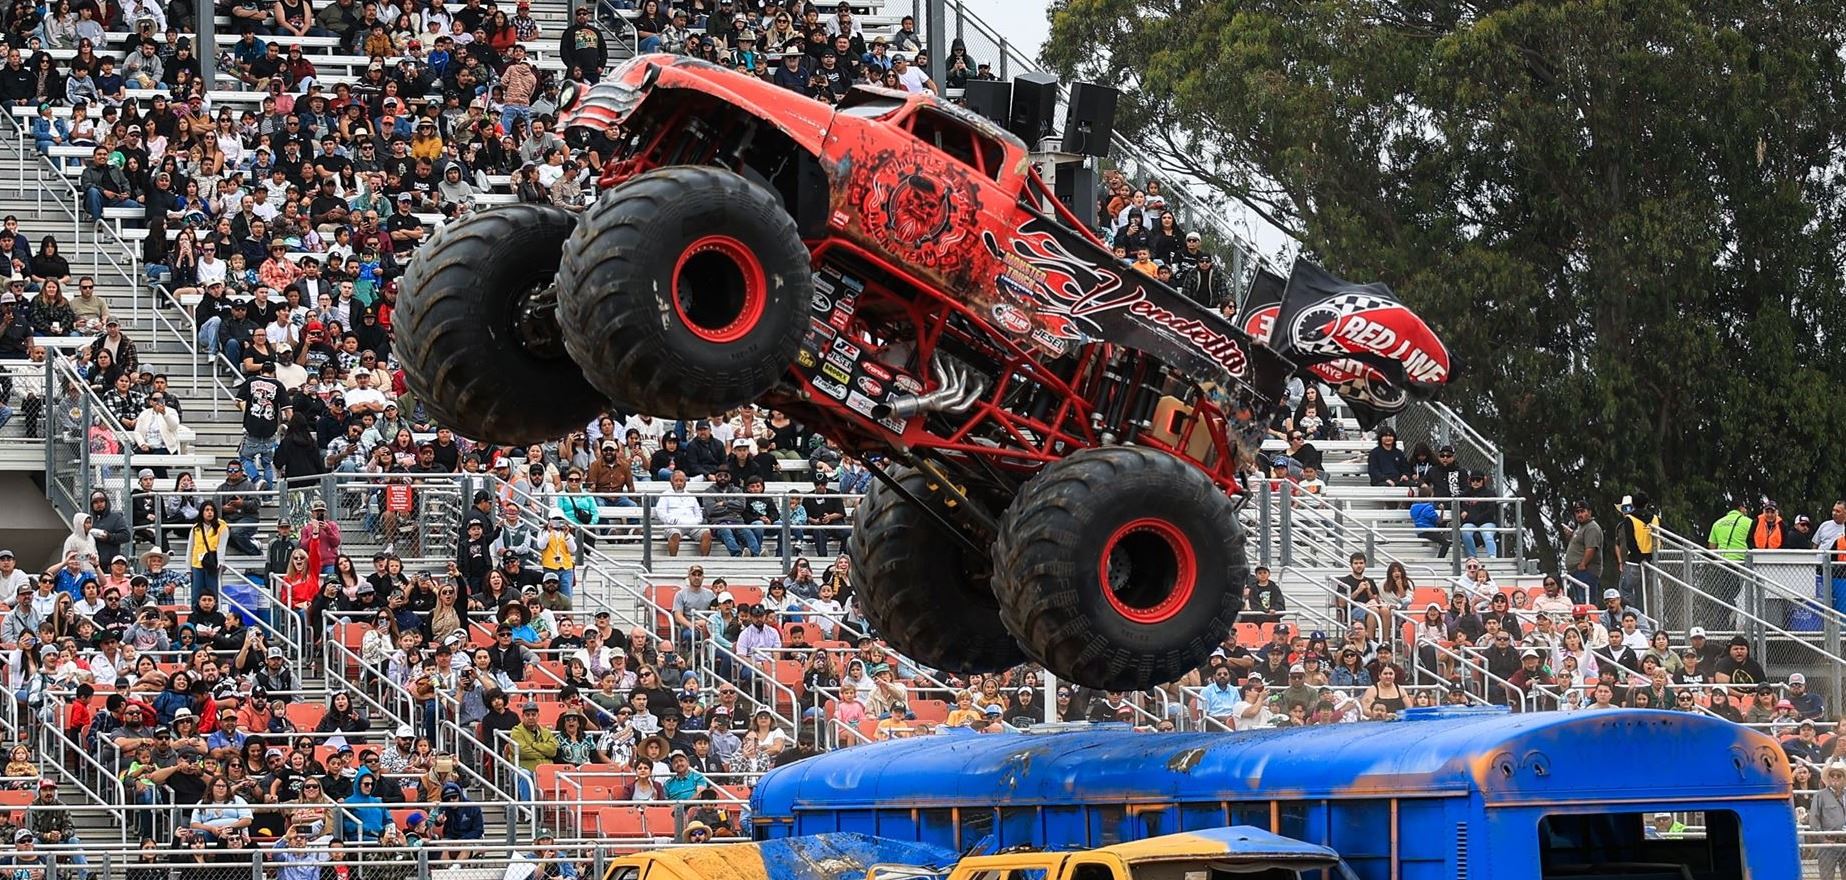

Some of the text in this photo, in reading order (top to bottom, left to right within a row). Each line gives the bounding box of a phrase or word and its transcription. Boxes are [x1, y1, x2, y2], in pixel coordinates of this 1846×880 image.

[1070, 268, 1248, 377] Vendetta
[1035, 328, 1064, 350] JESEL
[1338, 315, 1396, 350] RED
[1387, 339, 1447, 383] LINE
[828, 352, 853, 370] JESEL
[815, 377, 843, 398] Fragola
